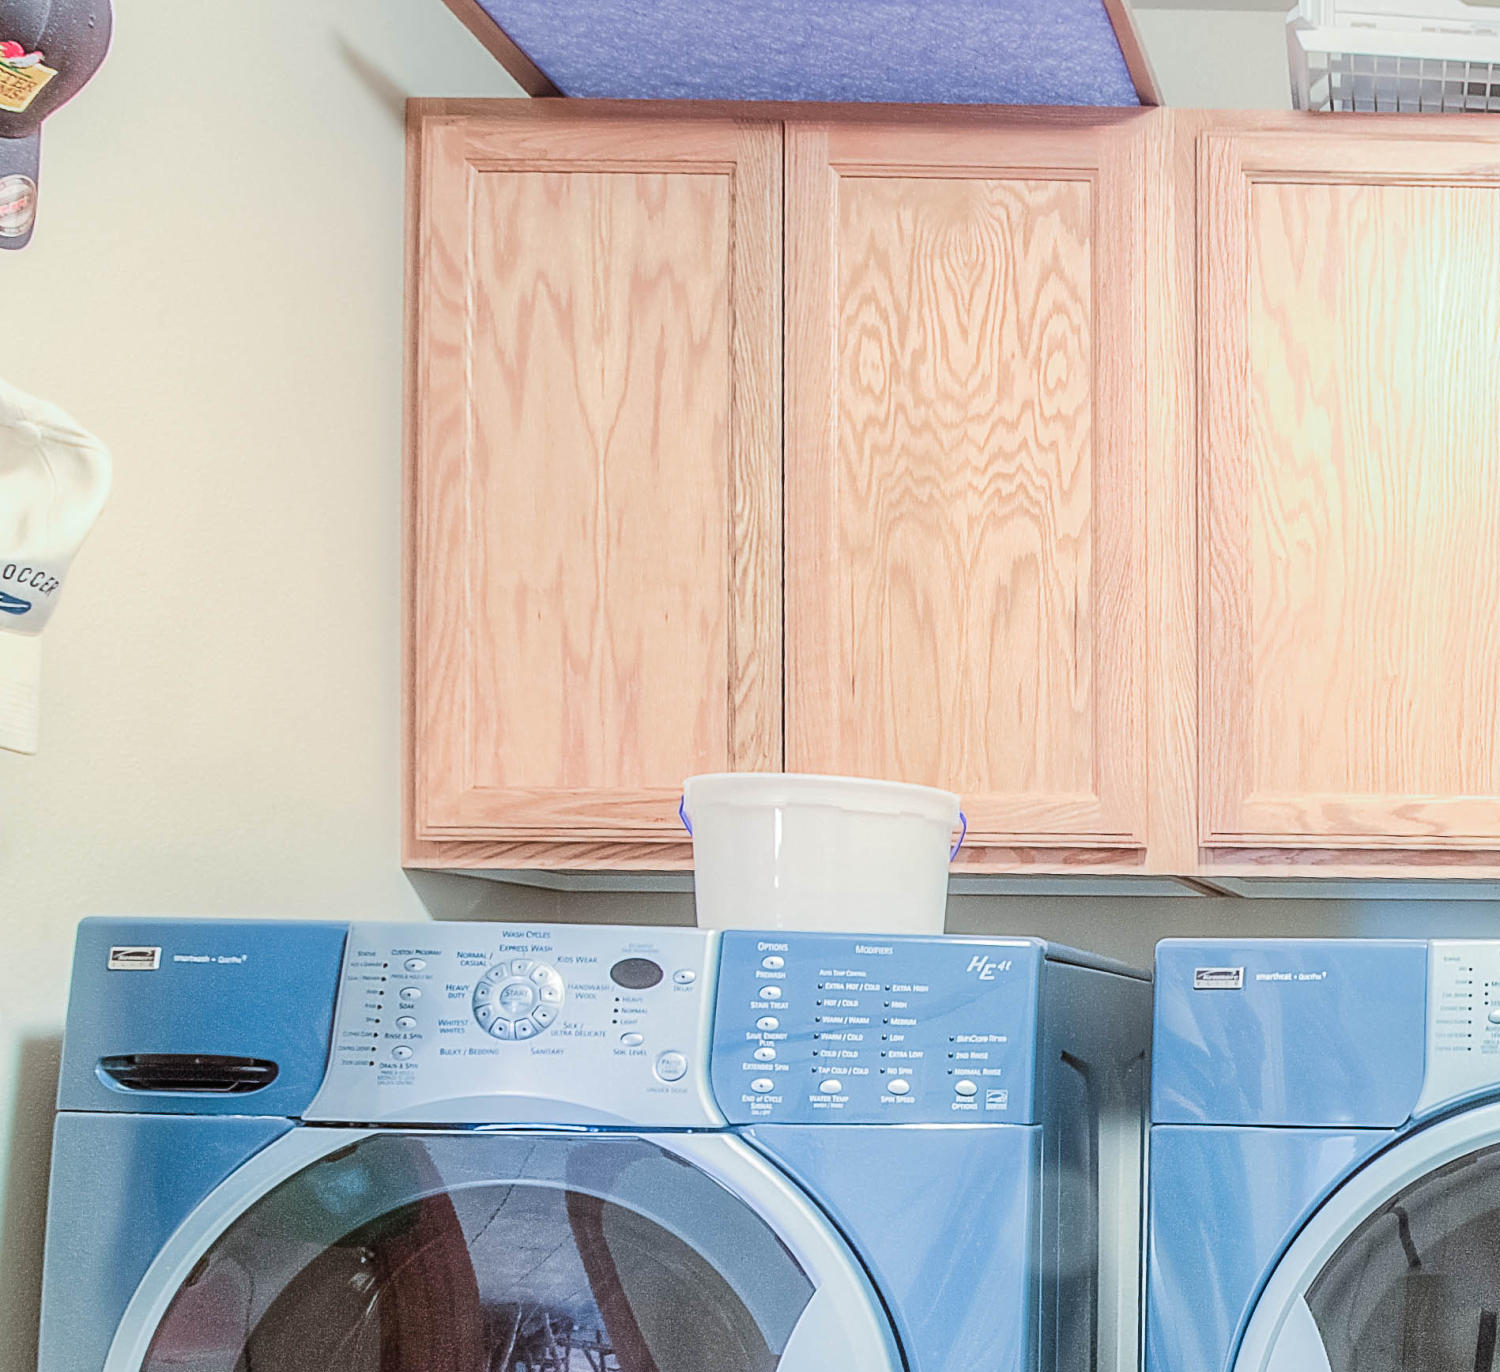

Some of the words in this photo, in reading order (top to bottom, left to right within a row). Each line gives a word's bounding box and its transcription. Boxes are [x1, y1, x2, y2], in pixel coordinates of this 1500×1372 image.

[2, 563, 60, 597] OCCER
[499, 944, 528, 952] EXPRESS
[758, 942, 788, 951] OPTIONS
[505, 989, 528, 997] START
